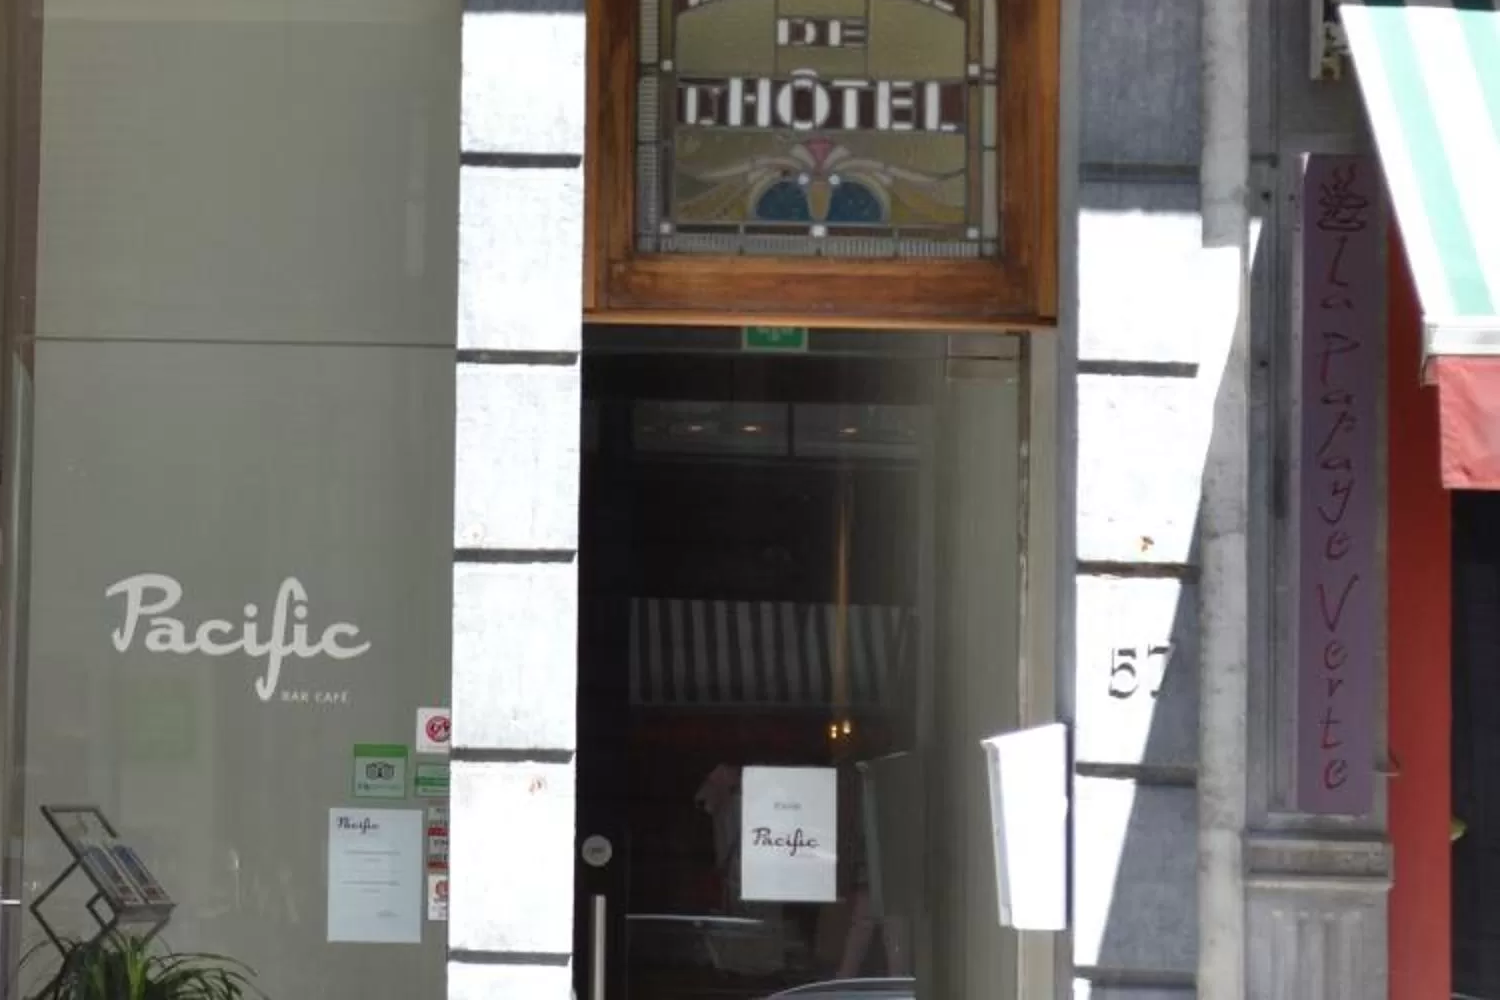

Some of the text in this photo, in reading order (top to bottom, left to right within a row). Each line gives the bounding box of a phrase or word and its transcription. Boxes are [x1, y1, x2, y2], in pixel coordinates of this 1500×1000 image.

[776, 16, 866, 48] DE
[105, 573, 371, 702] Pacific
[1316, 573, 1360, 790] Verte
[752, 827, 820, 857] Pacific
